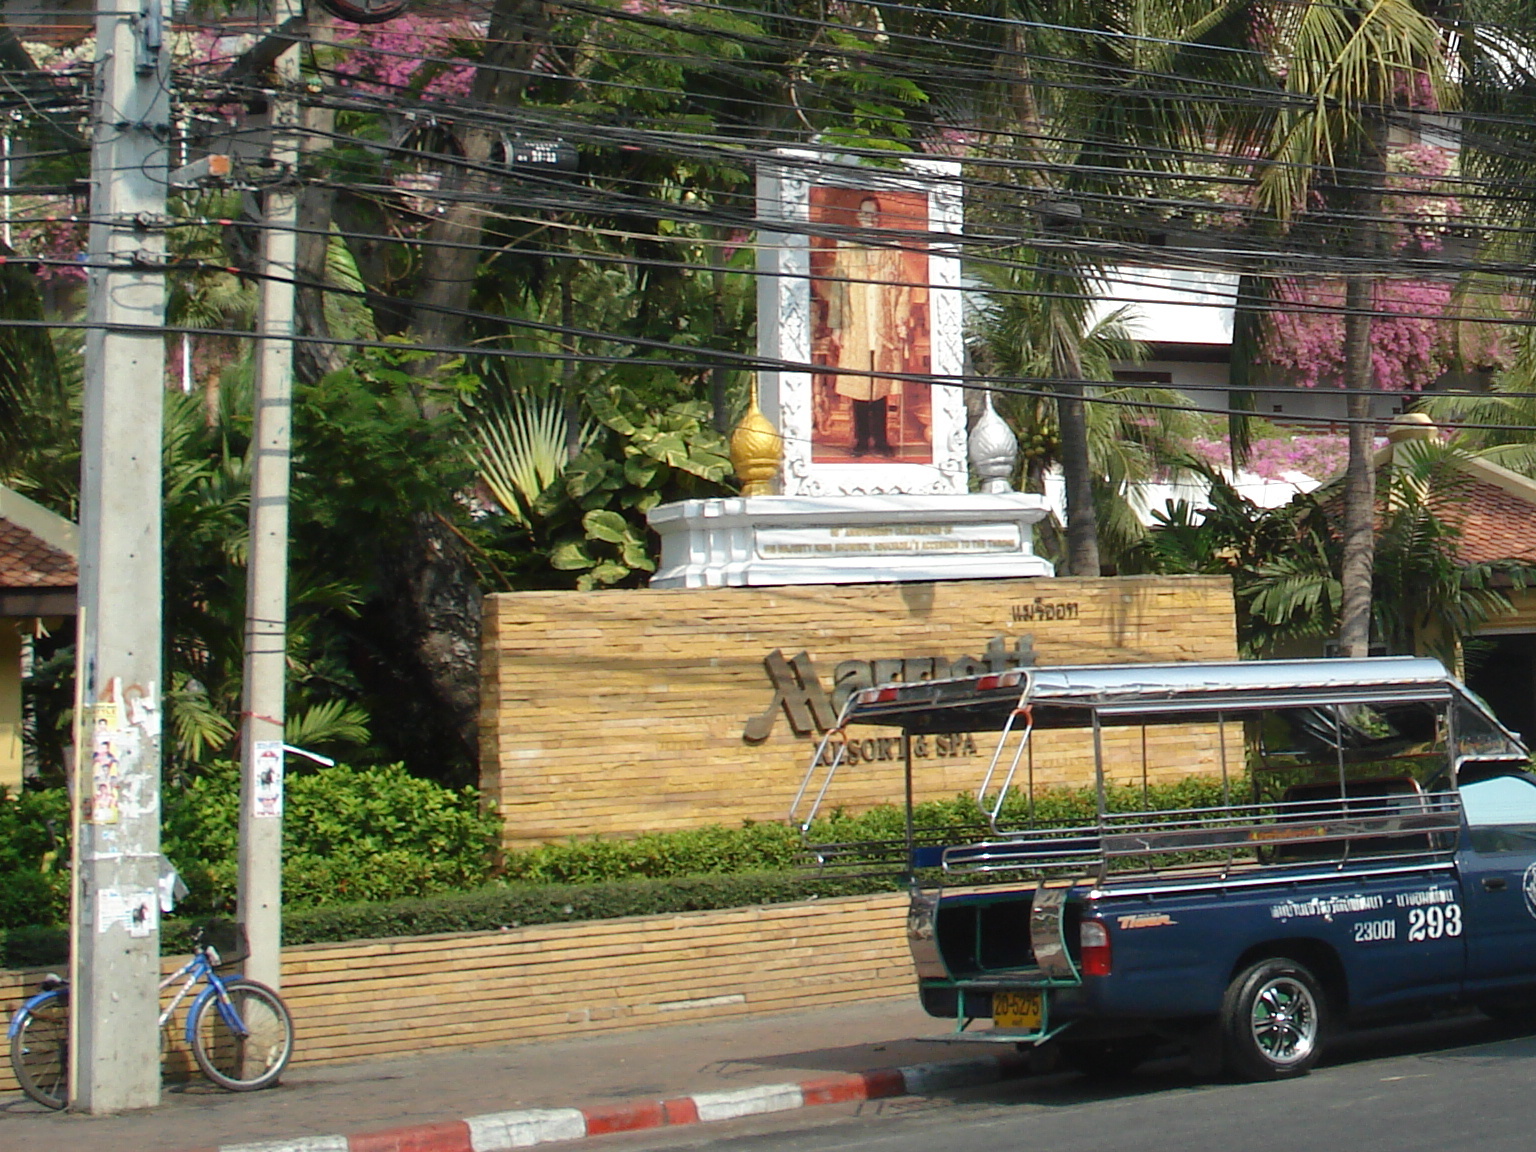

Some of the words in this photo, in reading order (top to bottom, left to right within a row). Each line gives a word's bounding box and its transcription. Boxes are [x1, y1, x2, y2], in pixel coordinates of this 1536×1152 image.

[935, 733, 978, 757] SPA
[1354, 919, 1396, 943] 23001
[1407, 904, 1463, 943] 293
